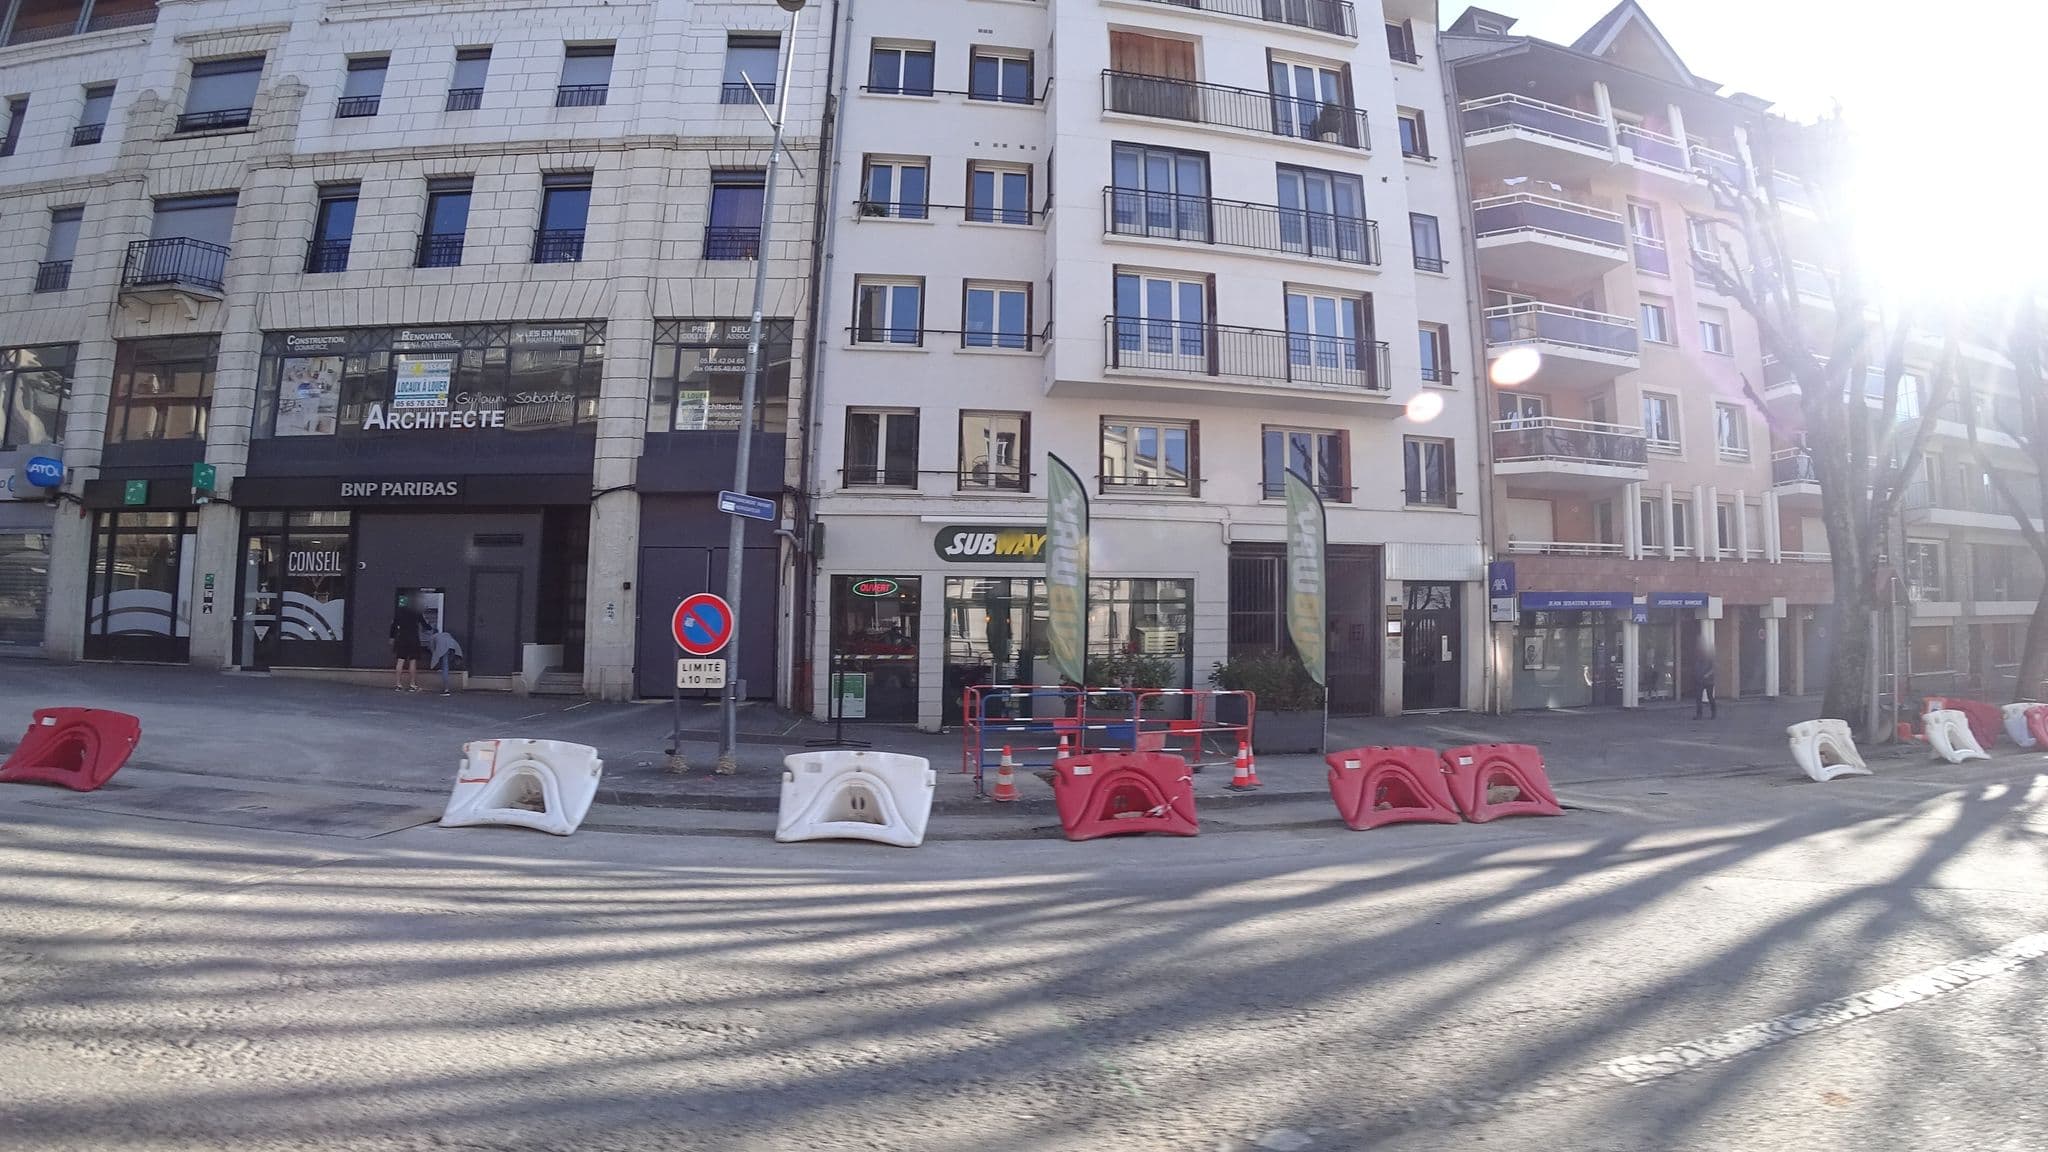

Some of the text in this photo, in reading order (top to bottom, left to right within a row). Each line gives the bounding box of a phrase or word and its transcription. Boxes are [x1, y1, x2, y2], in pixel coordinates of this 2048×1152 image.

[397, 381, 421, 393] LOCAUX
[428, 380, 448, 392] LOUER
[363, 404, 505, 430] ARCHITECTE
[341, 481, 458, 497] BNP PARIBAS
[944, 532, 1047, 555] SUBWAY
[289, 551, 342, 571] CONSEIL
[860, 583, 890, 593] OUVERT
[1492, 578, 1508, 591] AXA
[682, 662, 721, 672] LIMITÉ
[689, 676, 701, 684] 10
[705, 676, 722, 684] min
